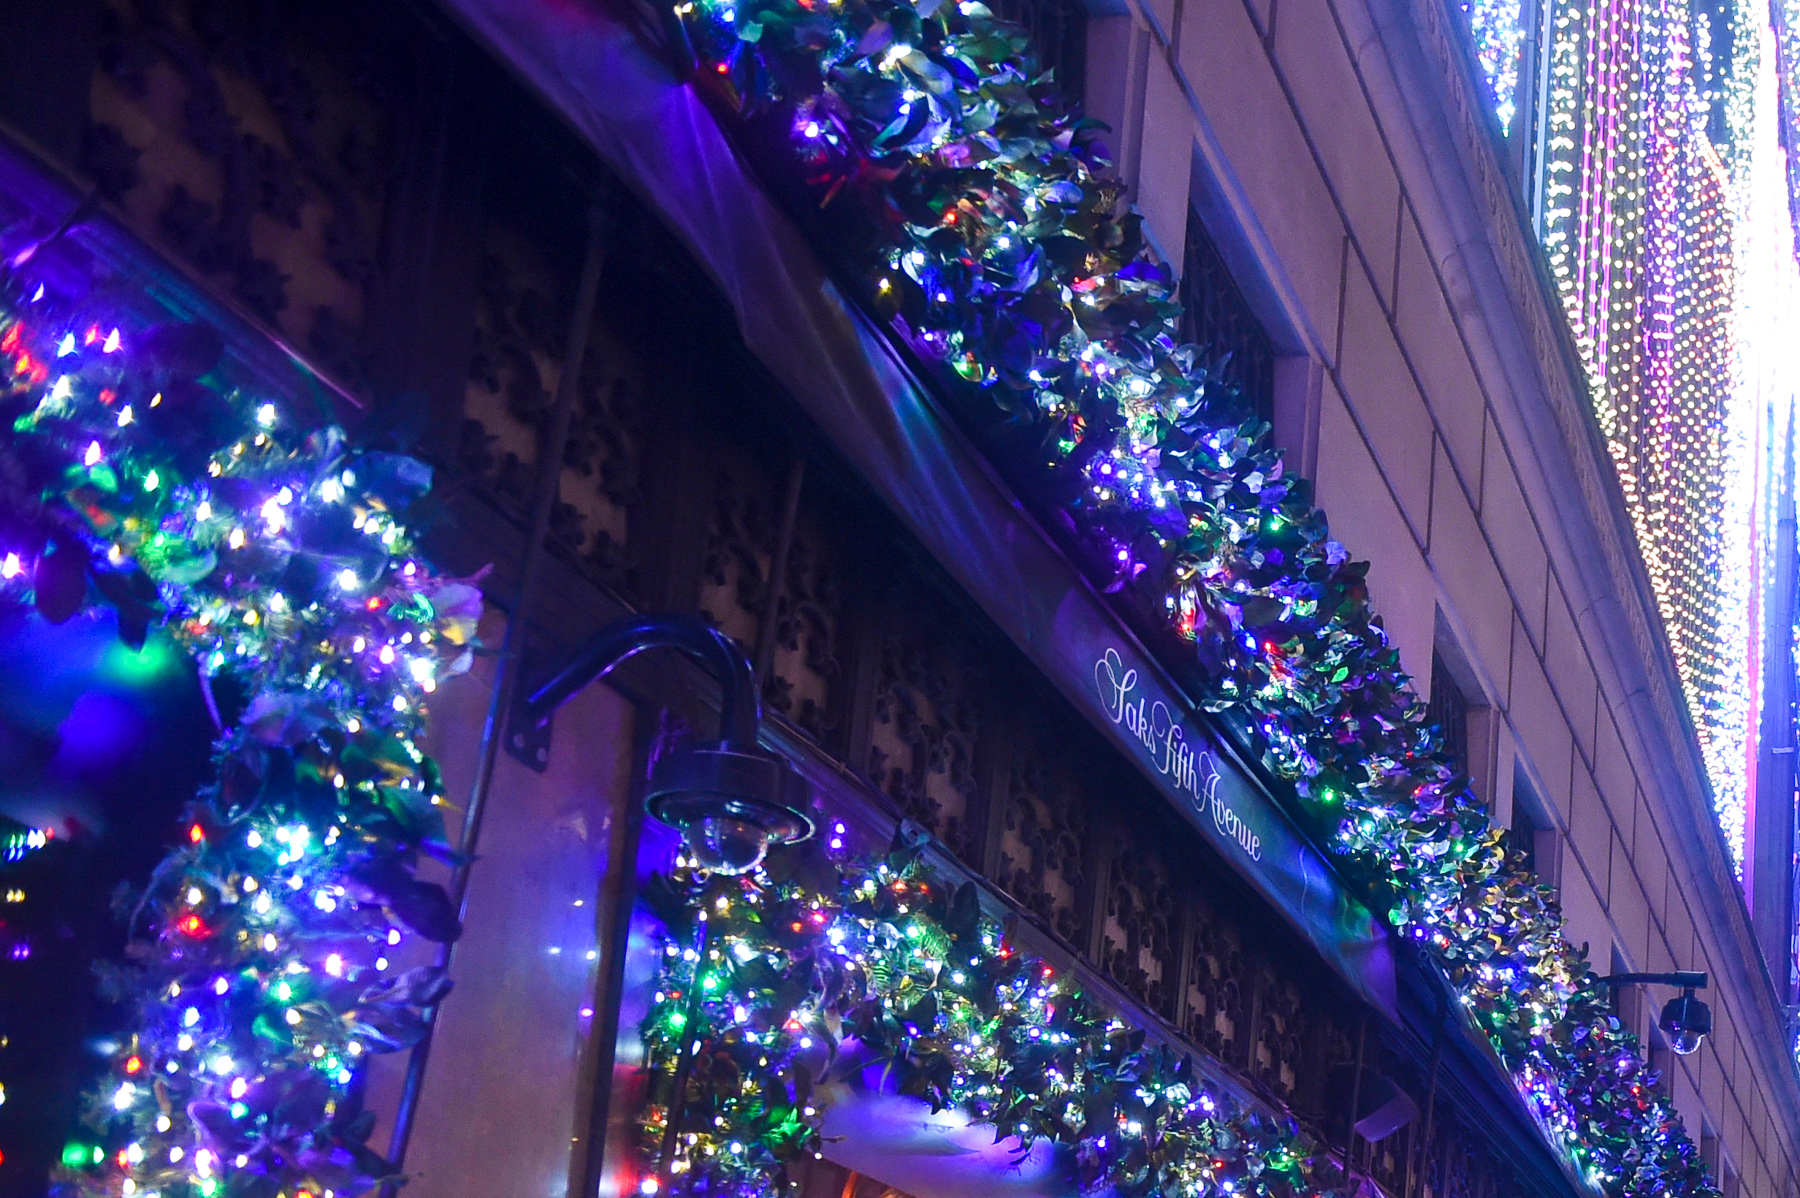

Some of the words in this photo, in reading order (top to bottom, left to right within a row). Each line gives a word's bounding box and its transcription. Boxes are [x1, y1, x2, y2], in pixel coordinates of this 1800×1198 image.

[1094, 648, 1156, 758] Saks
[1151, 701, 1199, 797] Fifth
[1191, 751, 1262, 862] Avenue
